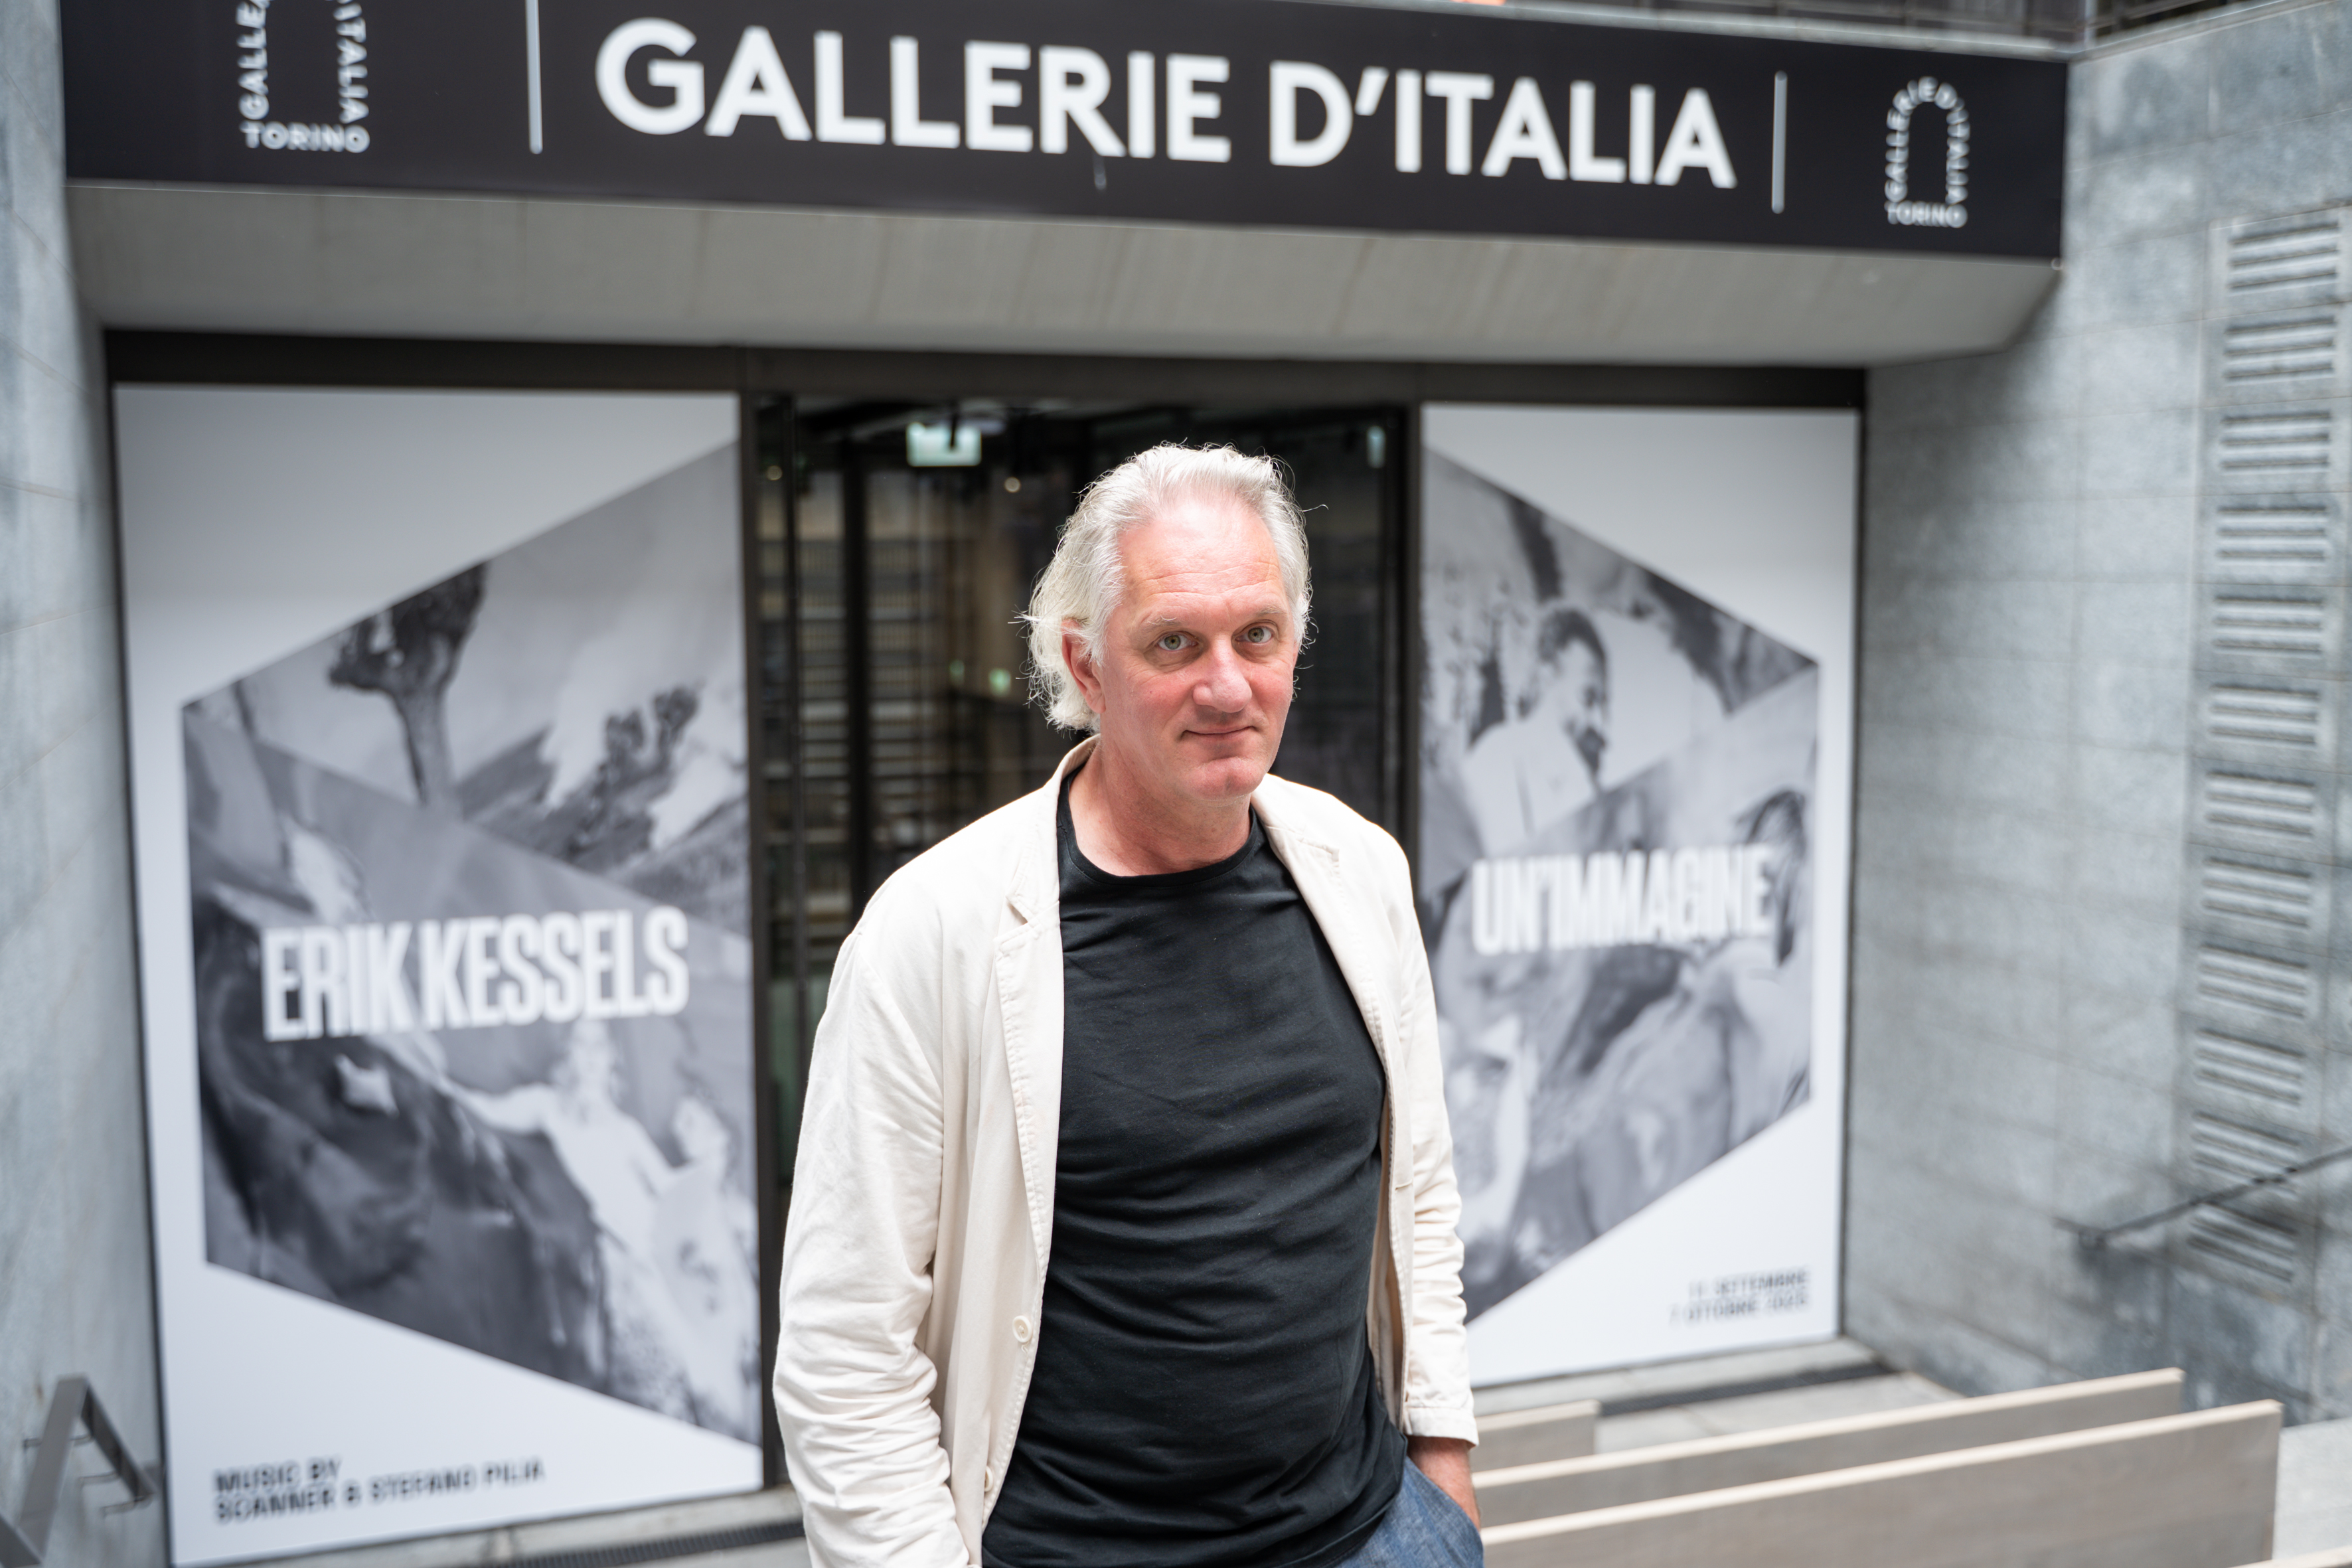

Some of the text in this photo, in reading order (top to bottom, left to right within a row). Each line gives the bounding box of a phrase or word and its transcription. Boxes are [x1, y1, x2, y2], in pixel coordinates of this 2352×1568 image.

[595, 17, 1738, 189] GALLERIE D'ITALIA
[239, 120, 370, 153] TORINO
[1884, 200, 1968, 228] TORINO
[263, 905, 690, 1042] ERIK KESSELS
[1711, 1265, 1811, 1295] SETTEMBRE
[1682, 1293, 1757, 1326] OTTOBRE
[213, 1454, 342, 1494] MUSIC BY
[213, 1482, 337, 1524] SCANNER
[367, 1463, 477, 1502] STEFANO
[481, 1454, 546, 1486] PILIA
